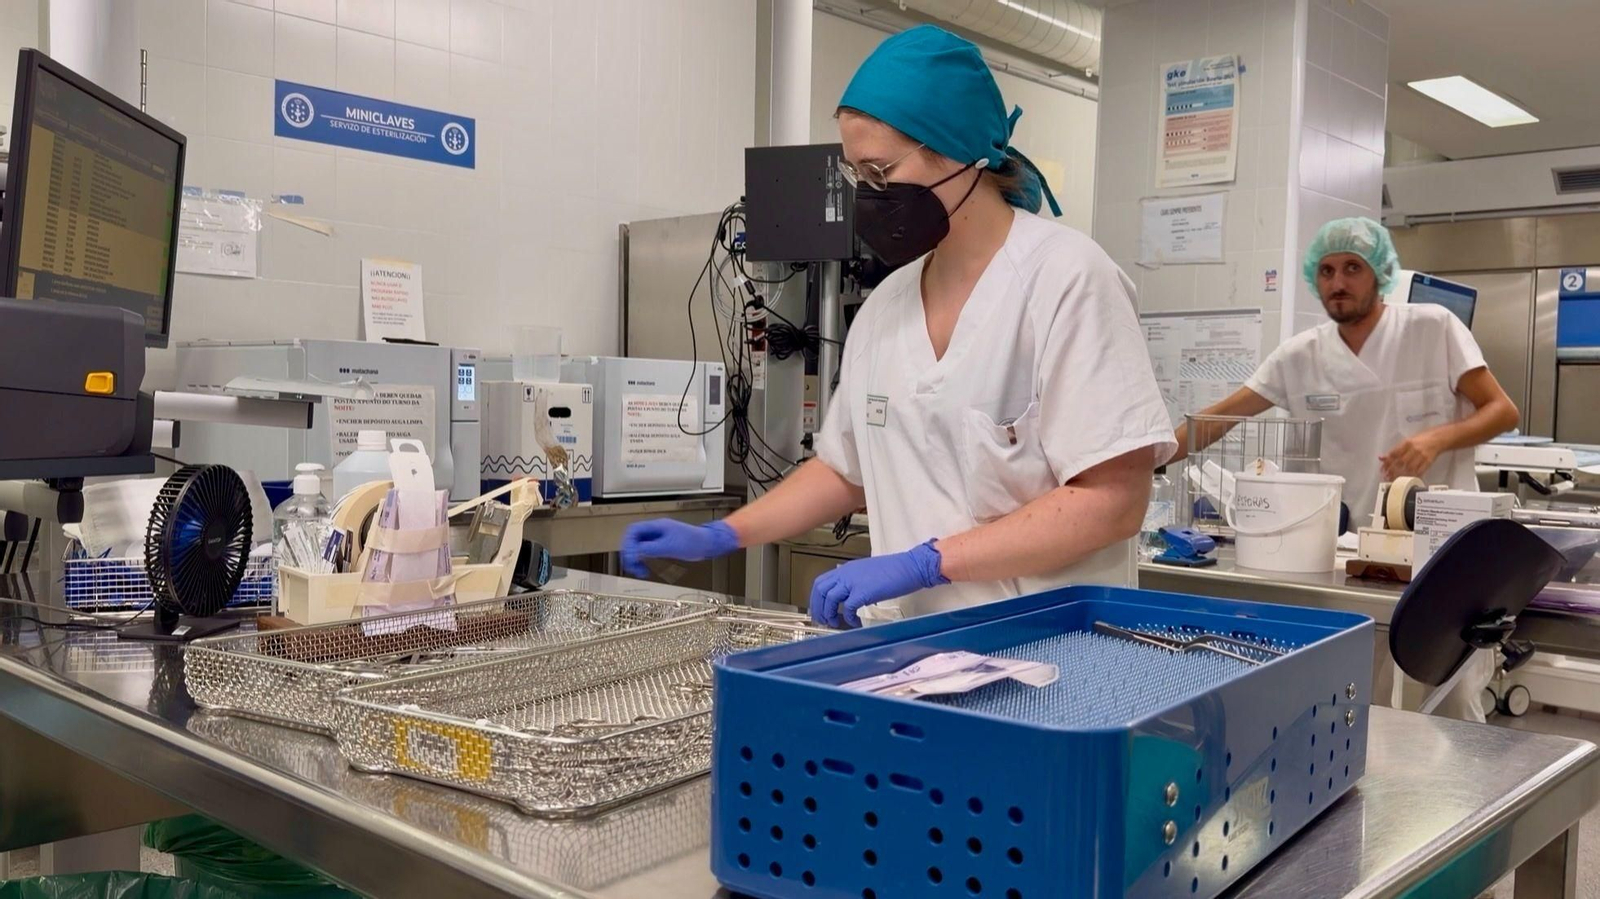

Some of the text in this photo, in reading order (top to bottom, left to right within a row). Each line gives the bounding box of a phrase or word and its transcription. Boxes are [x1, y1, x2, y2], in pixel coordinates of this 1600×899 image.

[1167, 69, 1186, 82] gke
[346, 106, 415, 130] MINICLAVES
[330, 119, 427, 144] SERVIZO DE ESTERILIZACIÓN
[1568, 275, 1578, 288] 2
